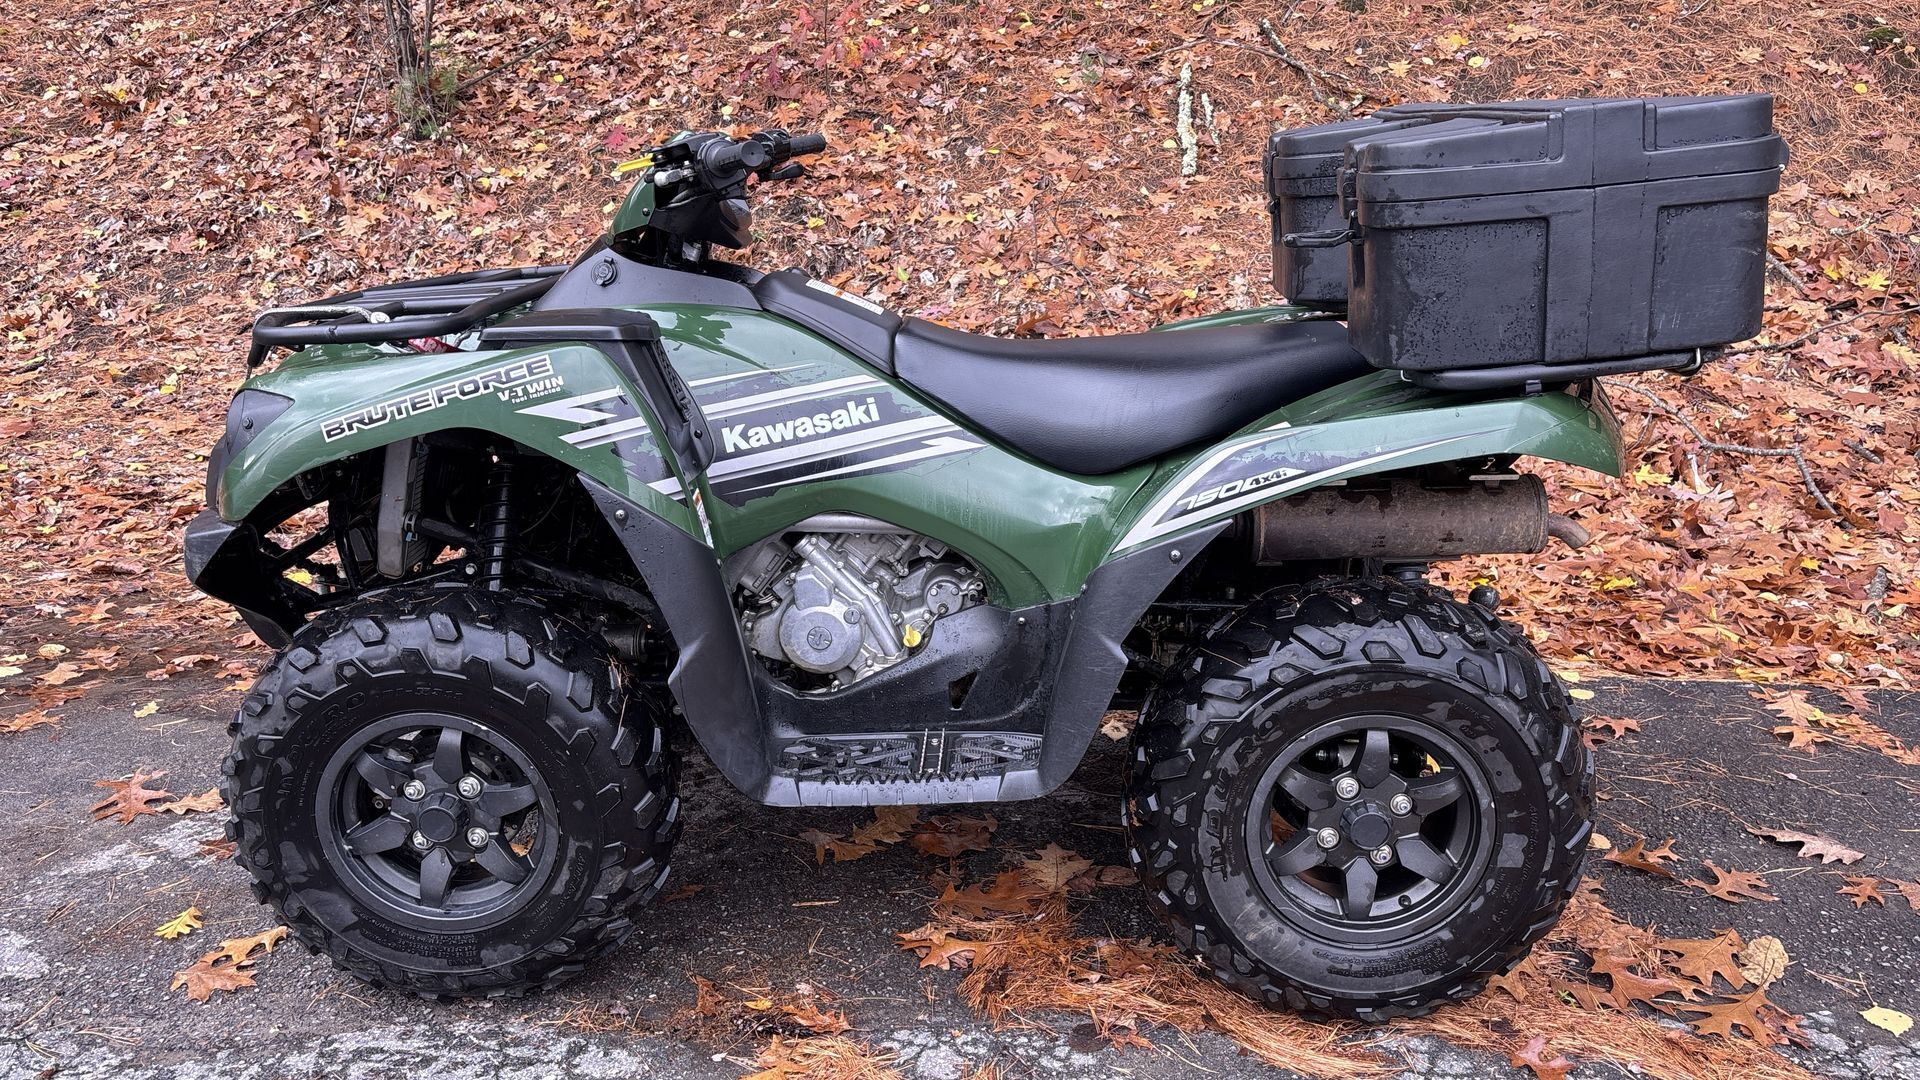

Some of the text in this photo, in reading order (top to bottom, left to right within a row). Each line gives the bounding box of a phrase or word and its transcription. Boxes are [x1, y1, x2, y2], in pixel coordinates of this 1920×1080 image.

[497, 376, 564, 401] V-TWIN
[721, 397, 880, 453] Kawasaki
[1176, 479, 1244, 510] 750
